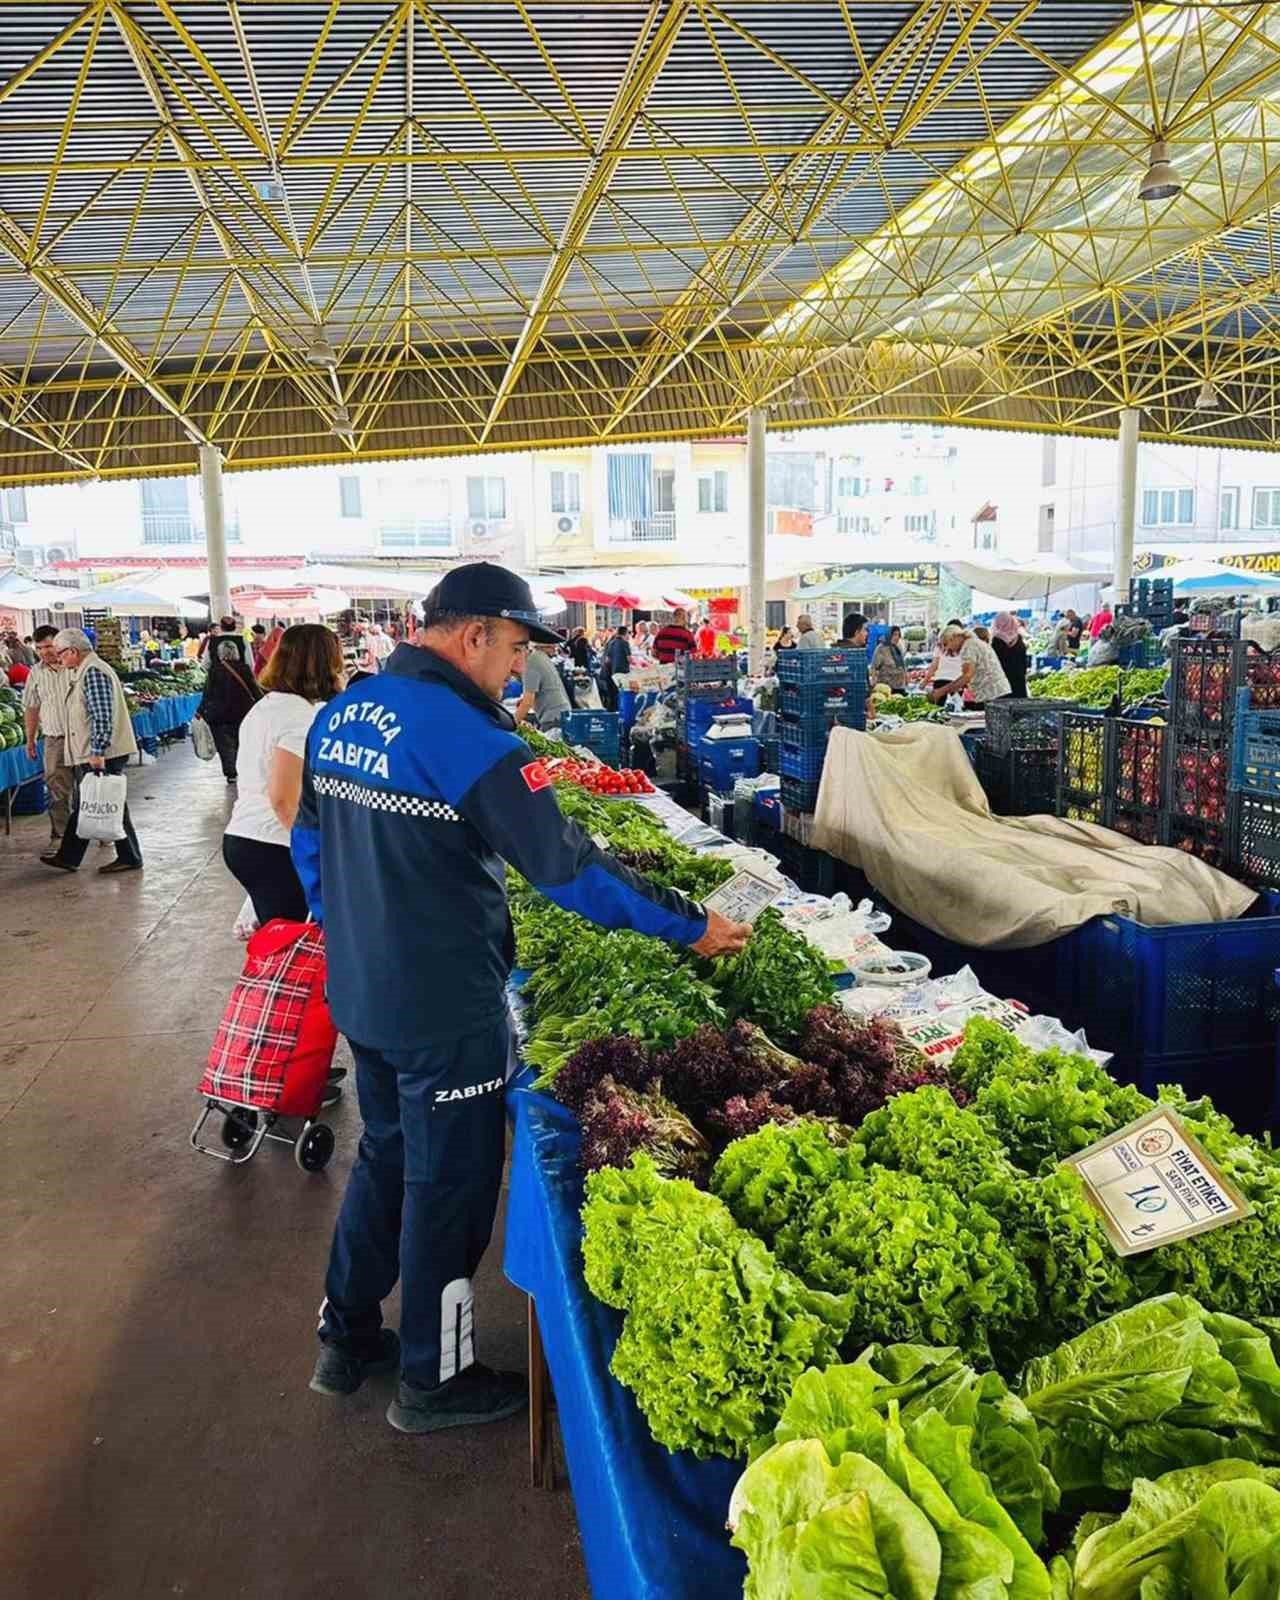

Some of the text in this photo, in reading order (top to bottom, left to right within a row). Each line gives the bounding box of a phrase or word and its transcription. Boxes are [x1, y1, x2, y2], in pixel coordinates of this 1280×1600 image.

[328, 701, 402, 747] ORTACA
[318, 736, 390, 780] ZABITA
[434, 1077, 504, 1103] ZABITA
[1125, 1185, 1168, 1213] 10
[1165, 1169, 1201, 1209] SATIŞ FİYATI
[1171, 1149, 1232, 1214] FİYAT ETİKETİ
